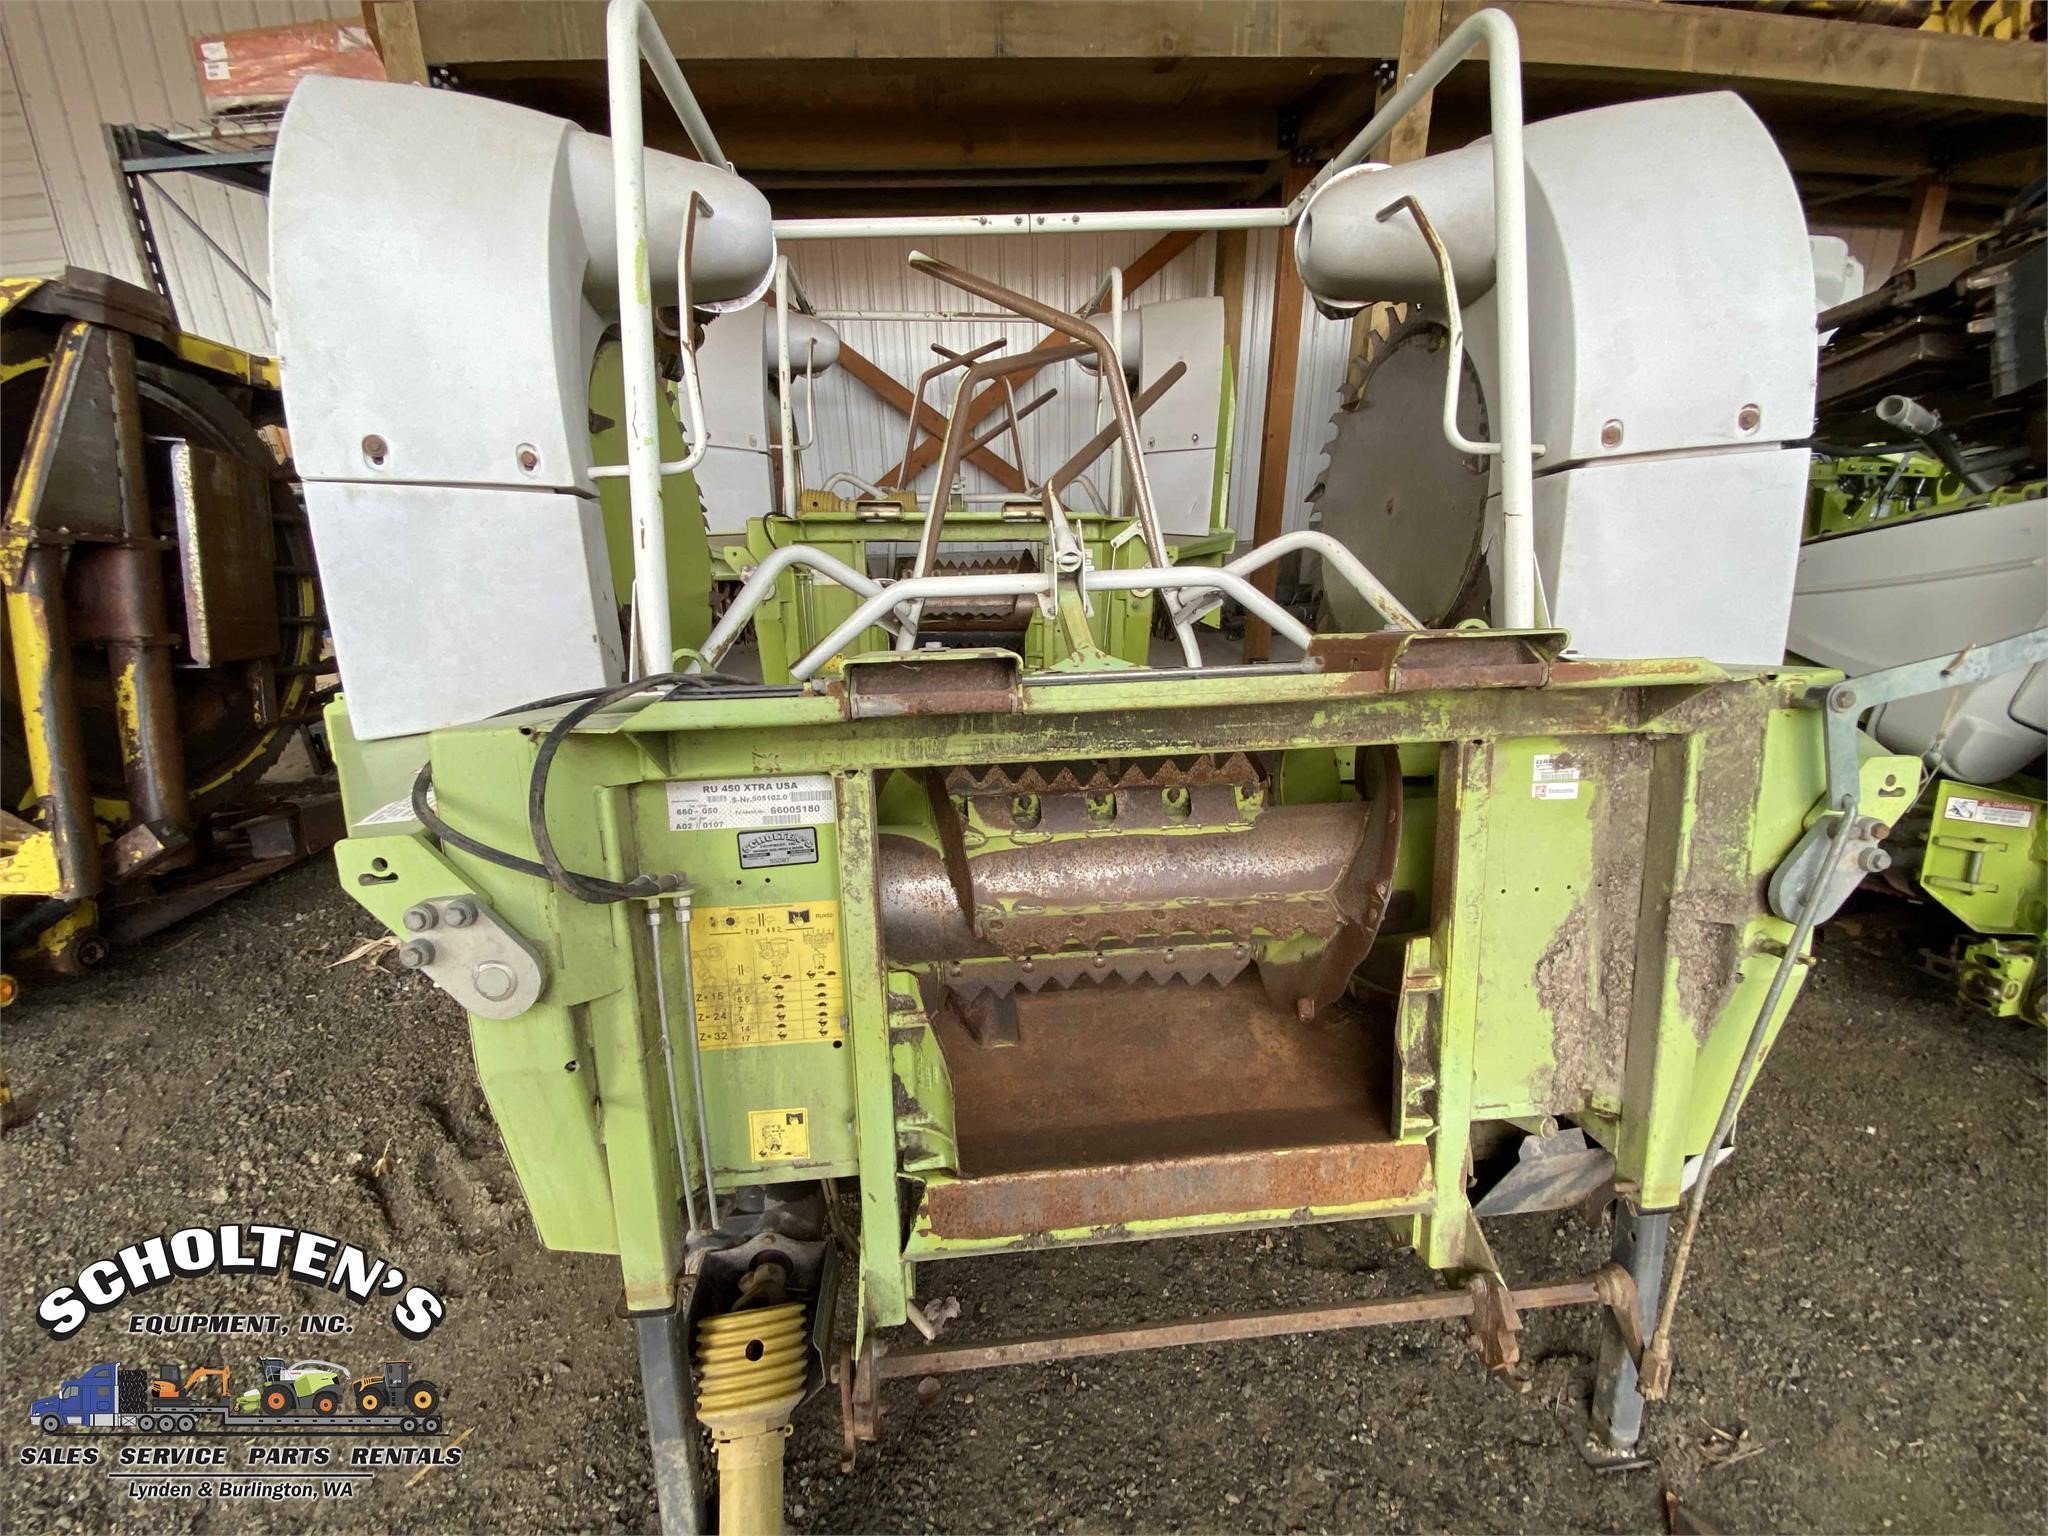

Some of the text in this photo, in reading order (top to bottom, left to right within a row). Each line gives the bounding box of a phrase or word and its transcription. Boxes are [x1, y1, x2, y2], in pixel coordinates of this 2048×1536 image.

[721, 785, 740, 793] 450
[744, 783, 773, 792] XTRA
[776, 782, 798, 790] USA
